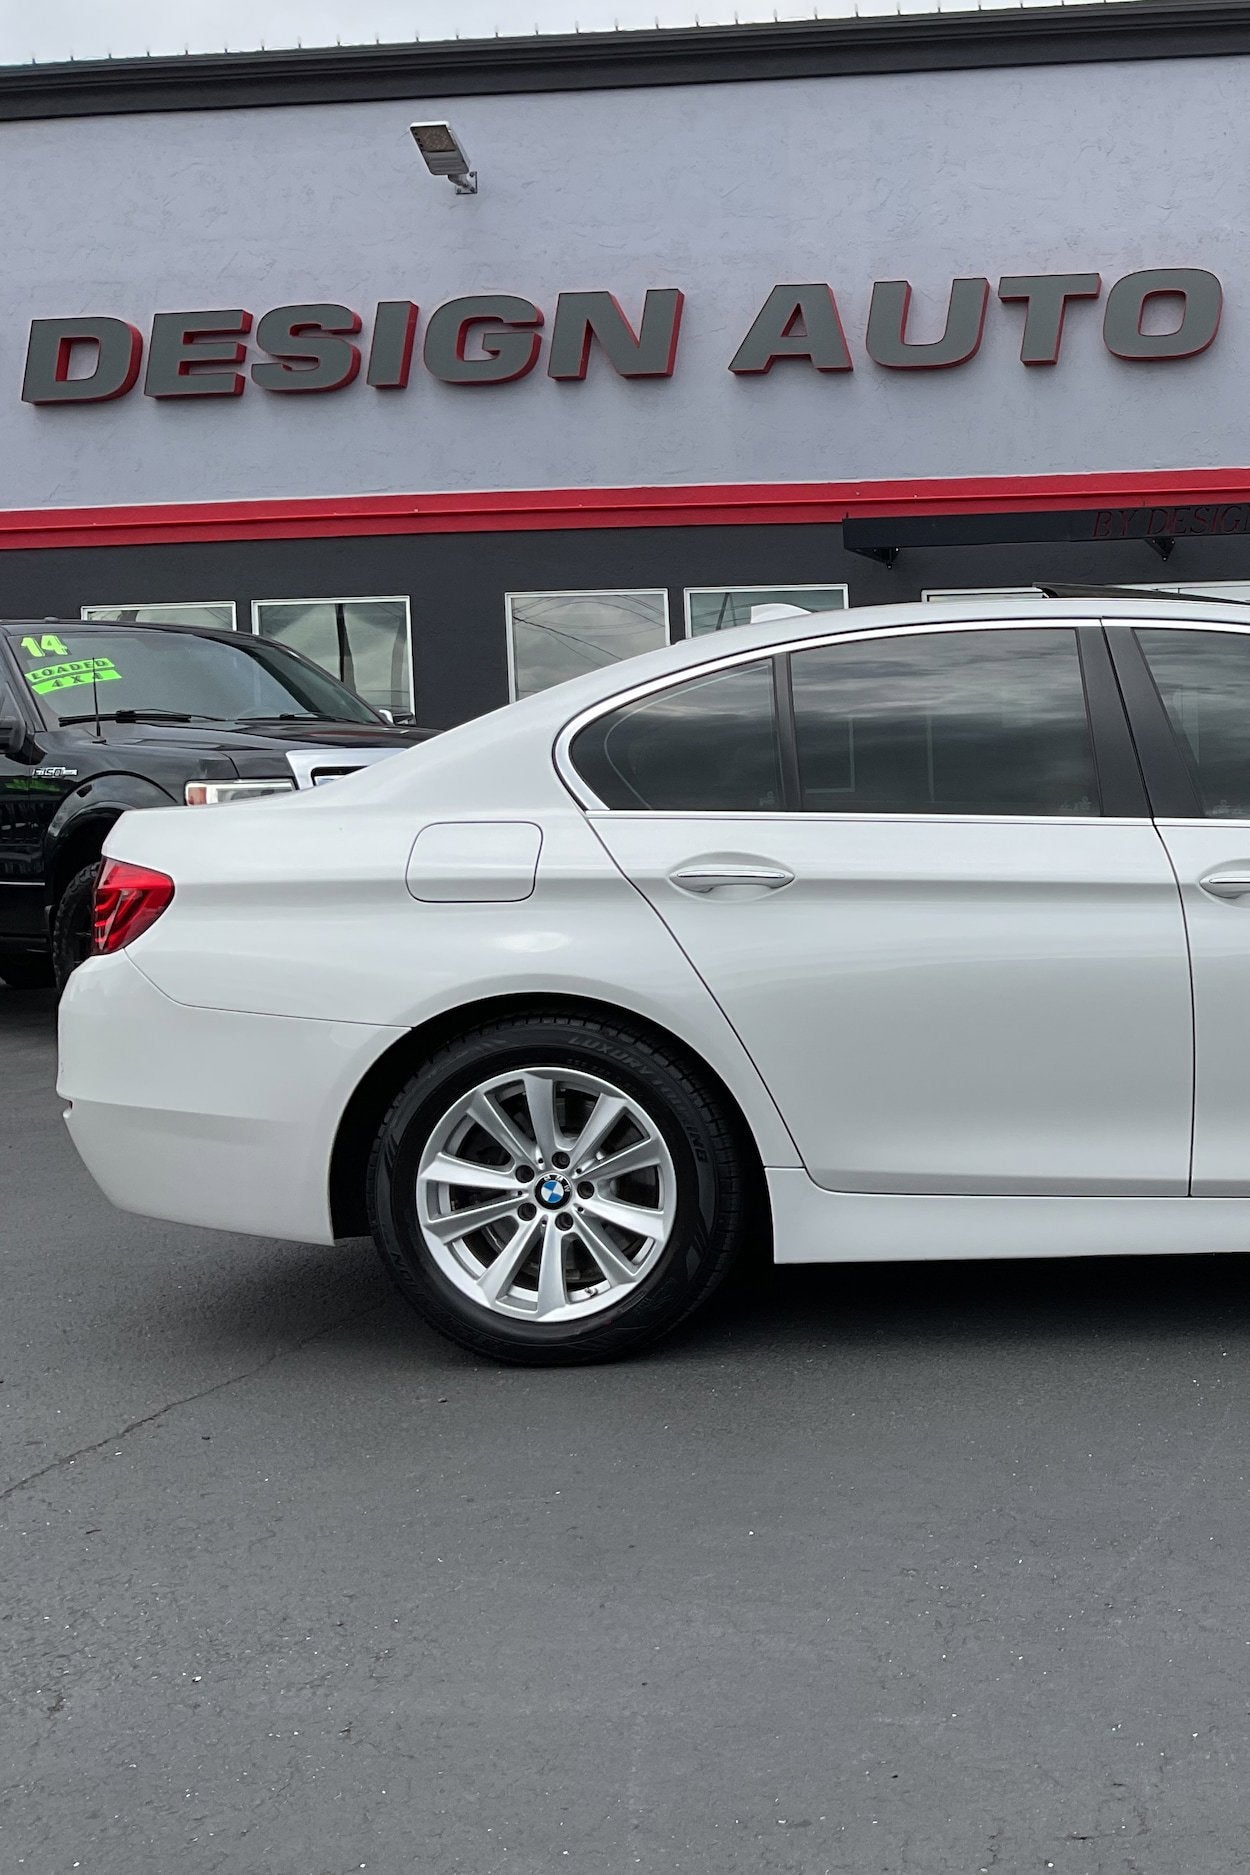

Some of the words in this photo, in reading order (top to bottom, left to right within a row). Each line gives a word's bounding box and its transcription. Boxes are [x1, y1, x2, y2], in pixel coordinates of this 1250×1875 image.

[21, 288, 685, 405] DESIGN
[727, 267, 1224, 374] AUTO
[1091, 510, 1137, 538] BY
[21, 635, 68, 657] 14
[30, 659, 107, 680] LOADED
[568, 1036, 654, 1075] LUXURY
